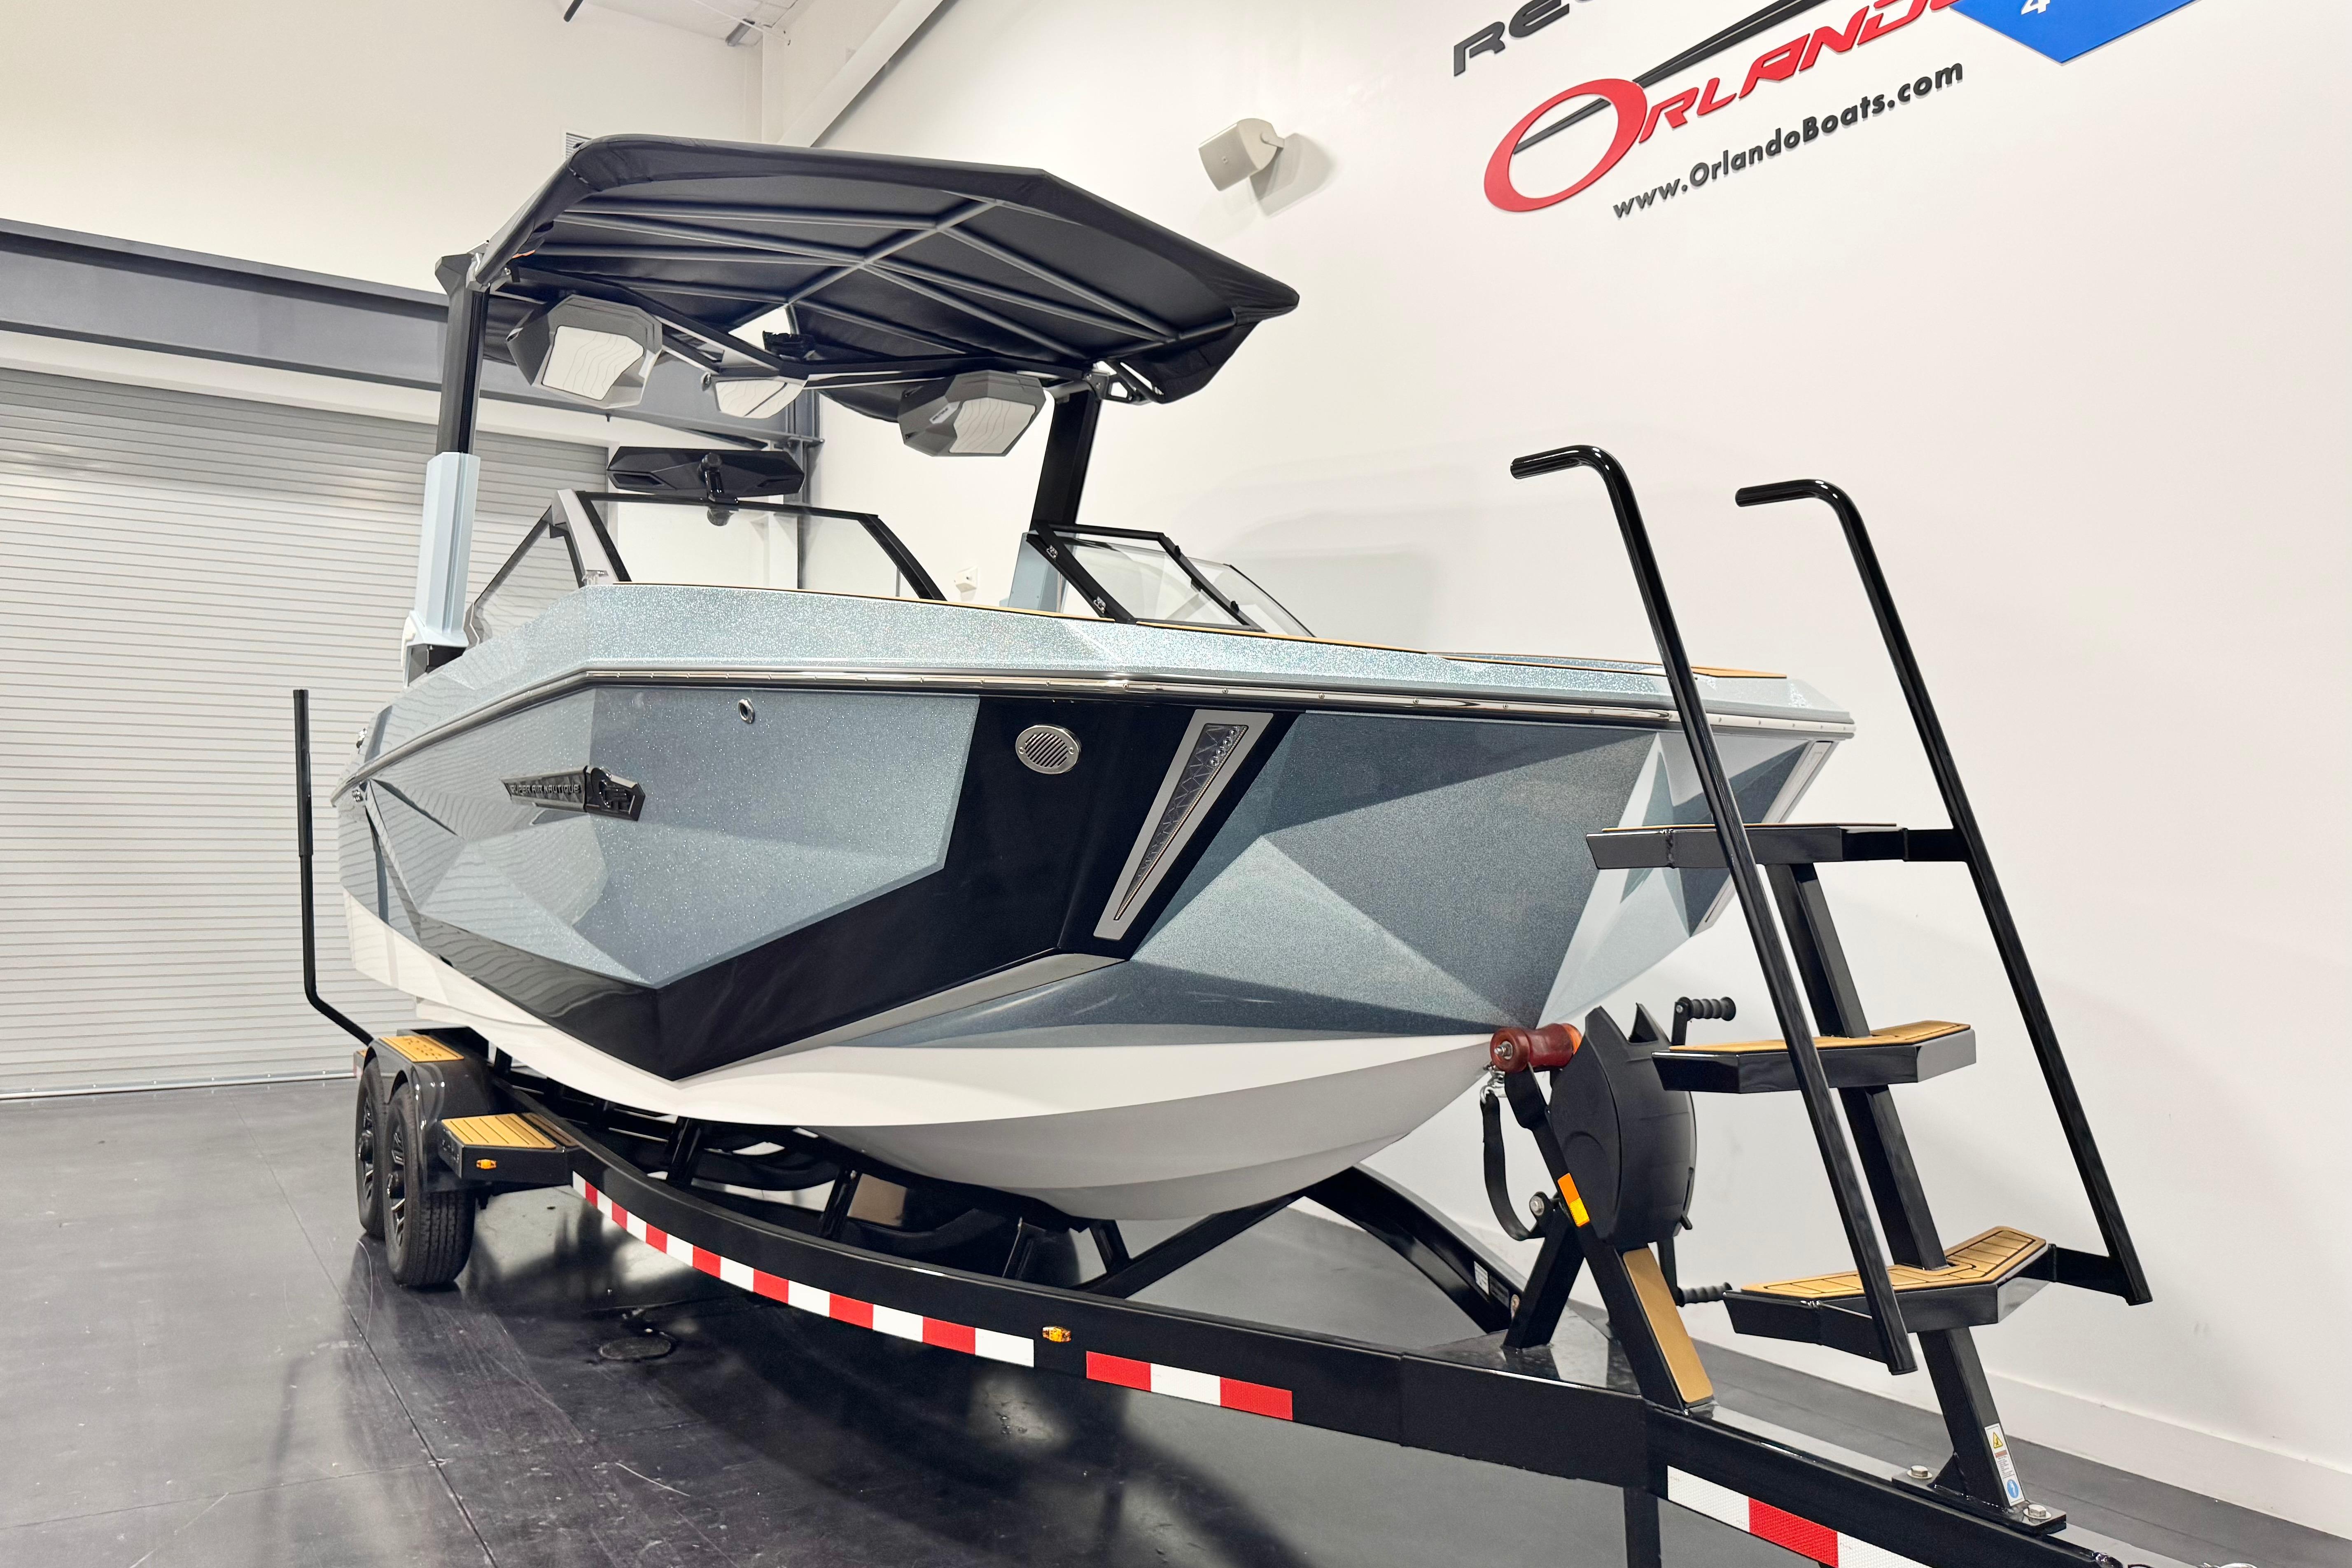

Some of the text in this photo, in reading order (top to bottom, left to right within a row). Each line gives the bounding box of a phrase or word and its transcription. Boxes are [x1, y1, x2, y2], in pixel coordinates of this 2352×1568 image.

[1484, 0, 1956, 212] ORLAND
[1613, 63, 1963, 219] www.OrlandoBoats.com
[531, 784, 543, 794] AIR
[543, 784, 581, 795] NAUTIQUE
